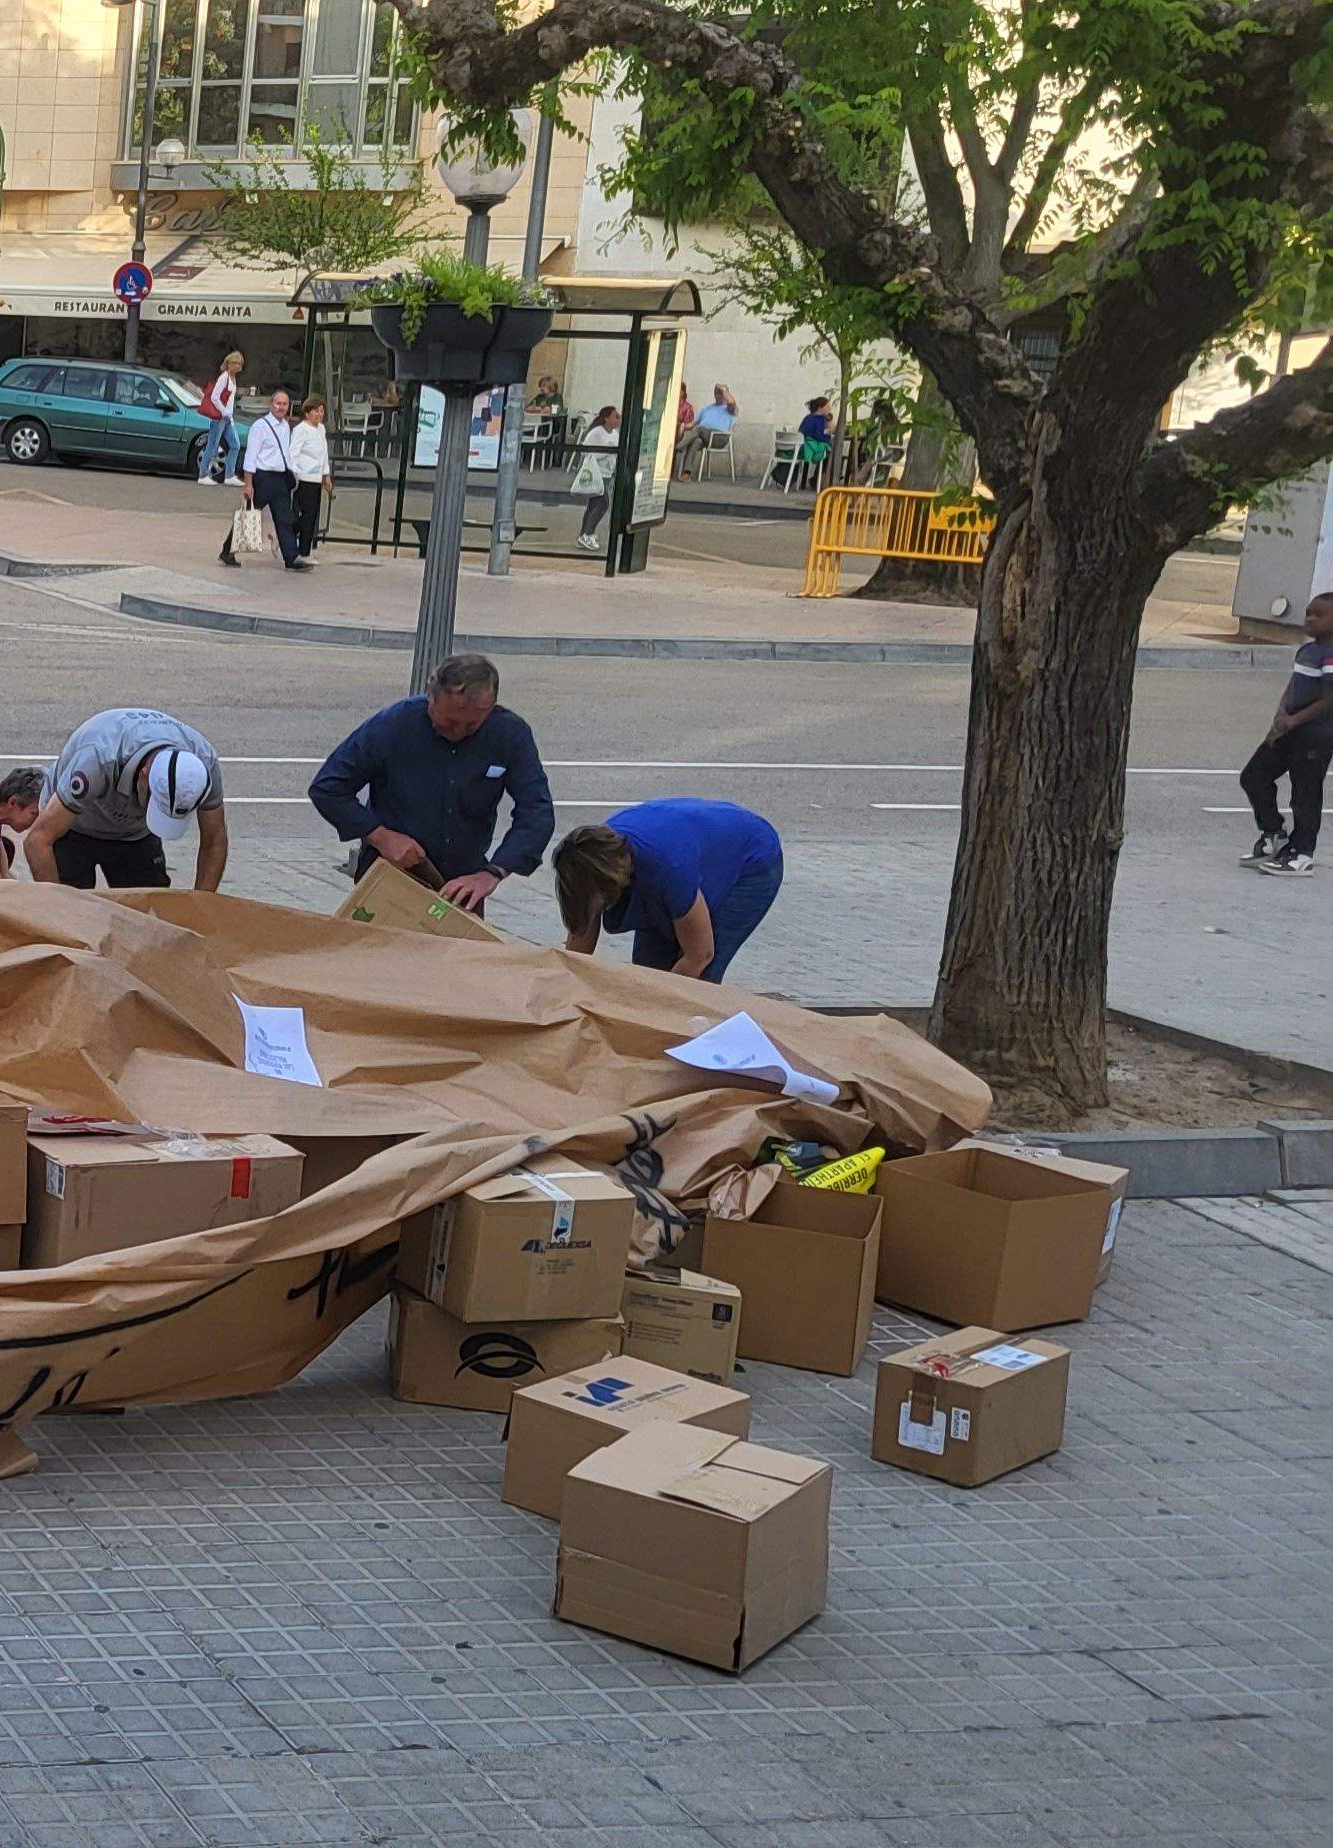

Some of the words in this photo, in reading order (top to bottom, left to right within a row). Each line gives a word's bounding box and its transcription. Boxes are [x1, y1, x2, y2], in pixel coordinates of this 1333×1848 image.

[53, 301, 126, 315] RESTAURAN
[157, 304, 208, 317] GRANJA
[211, 305, 253, 318] ANITA
